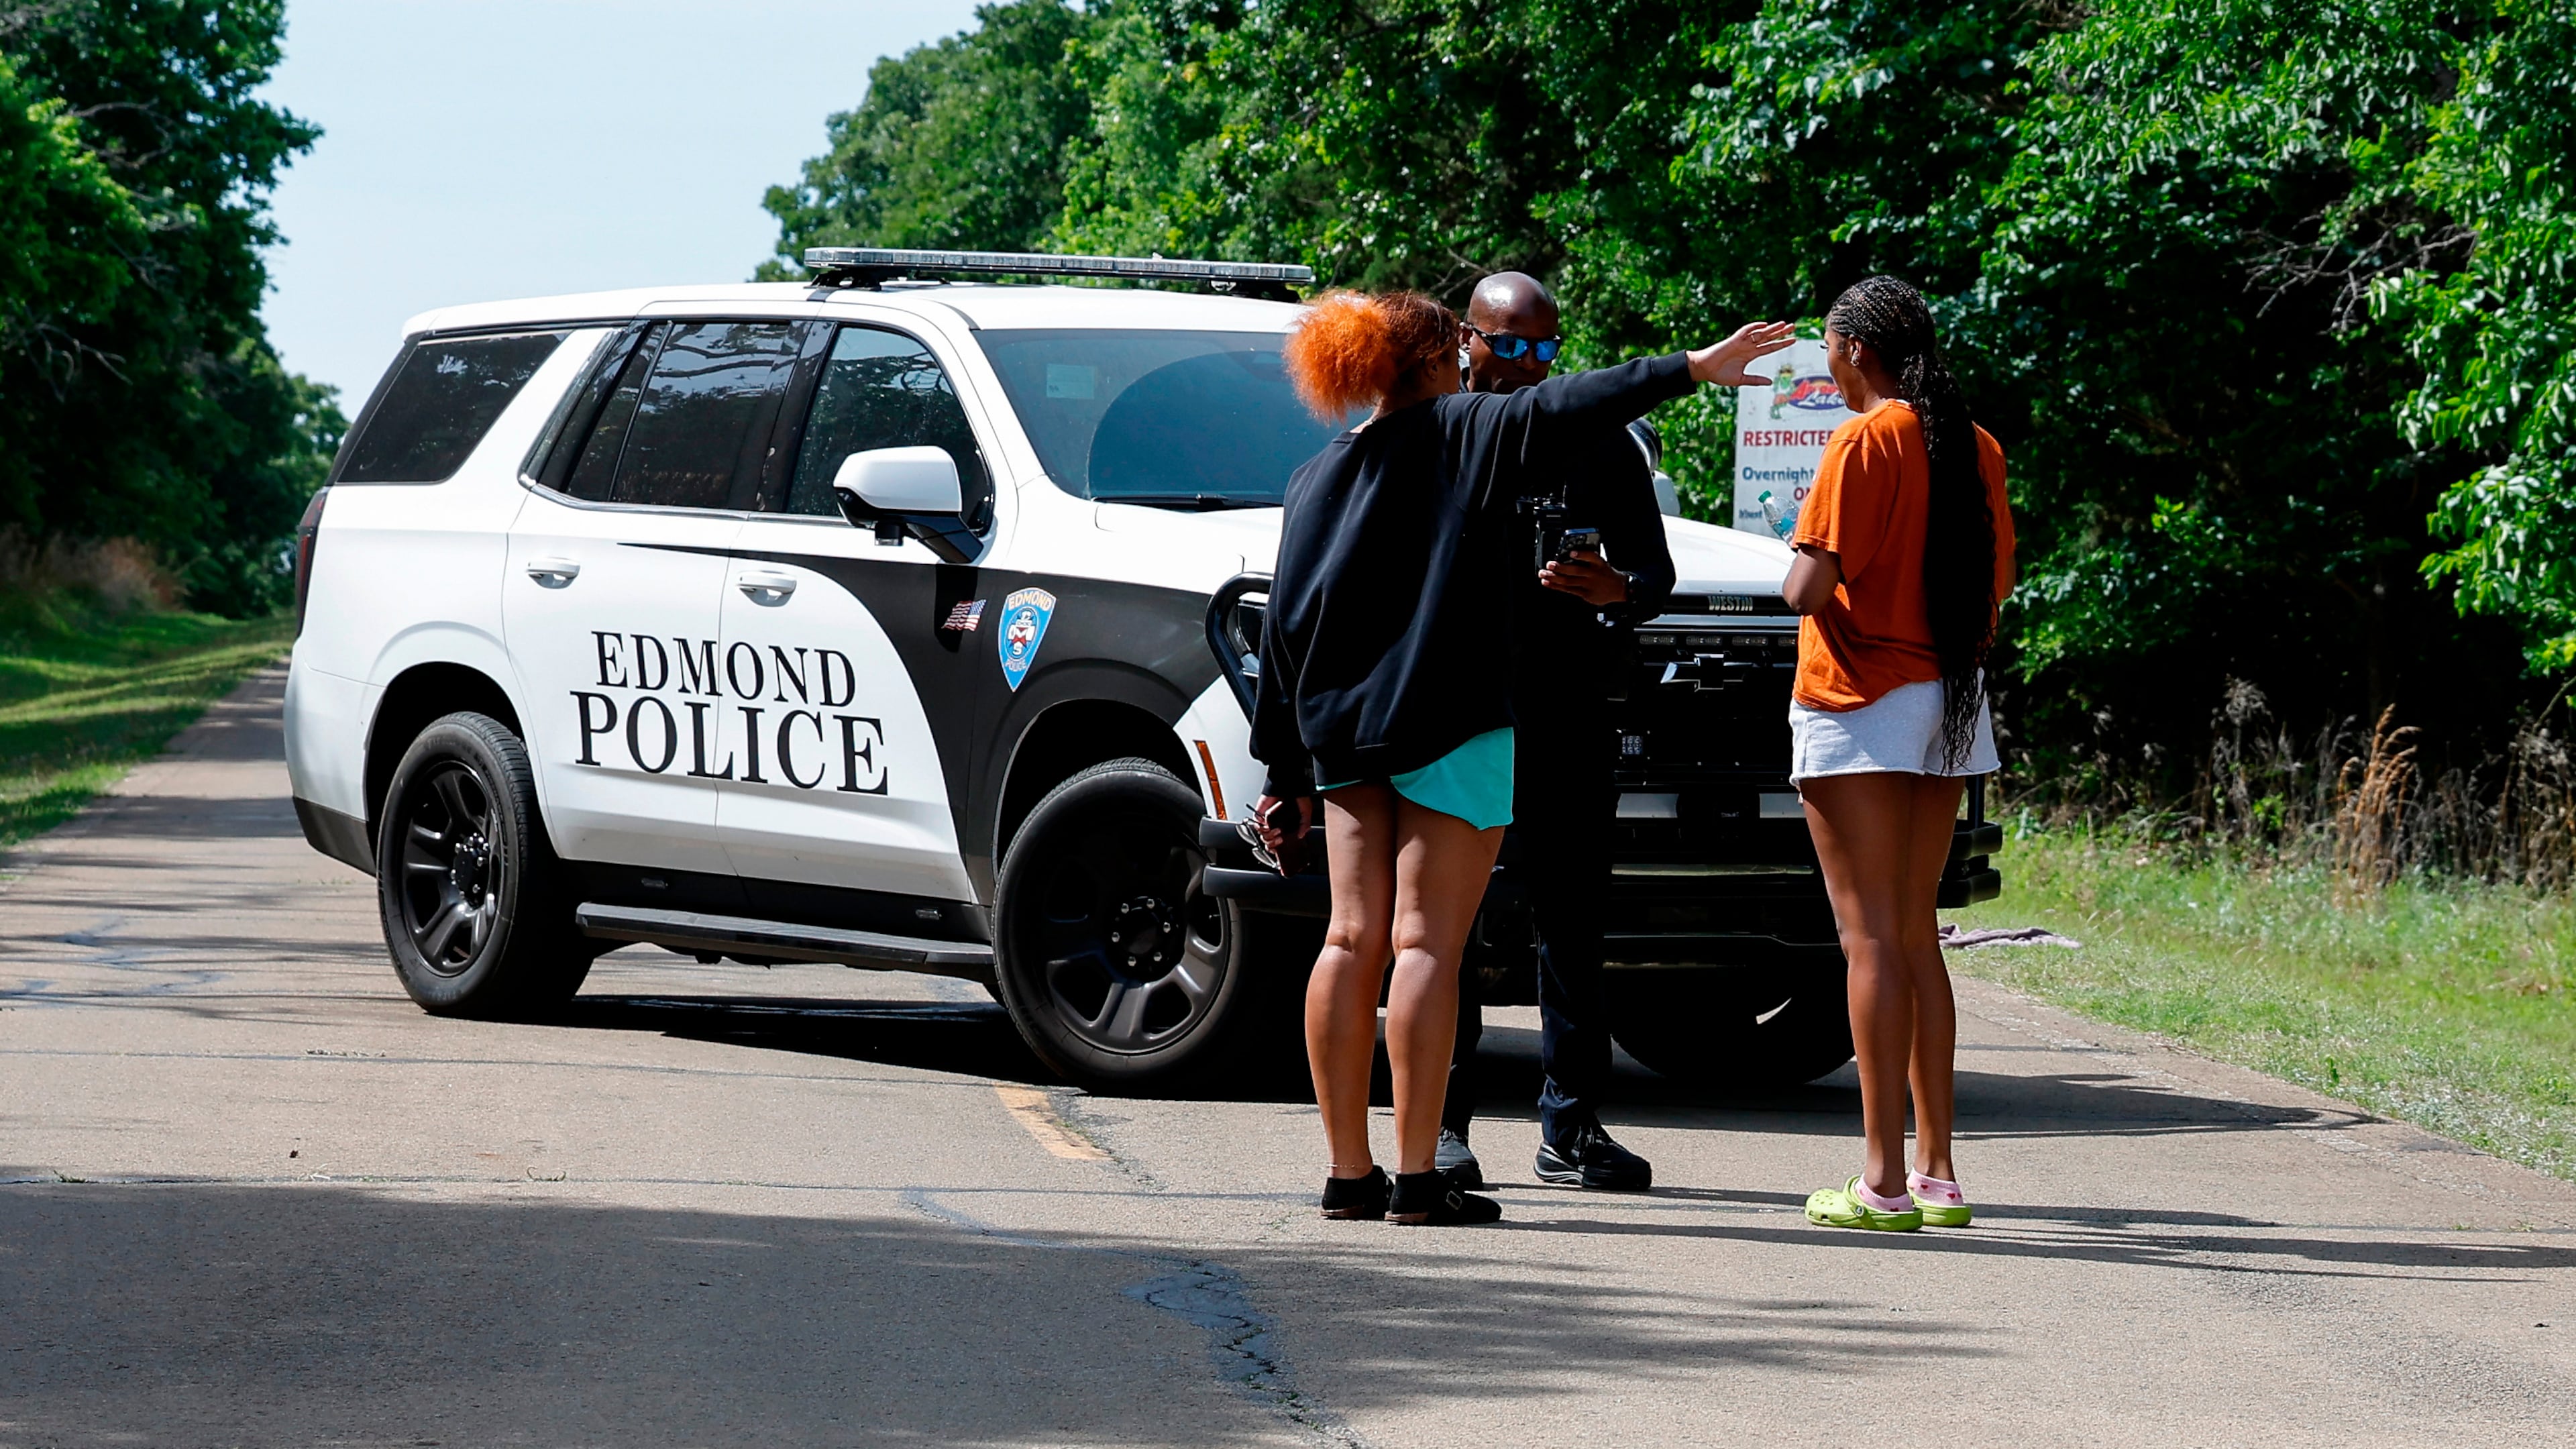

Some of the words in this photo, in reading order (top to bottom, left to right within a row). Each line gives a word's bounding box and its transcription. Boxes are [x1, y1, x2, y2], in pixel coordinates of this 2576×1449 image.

[1008, 592, 1052, 611] EDMOND
[591, 631, 855, 707] EDMOND
[570, 690, 888, 796] POLICE
